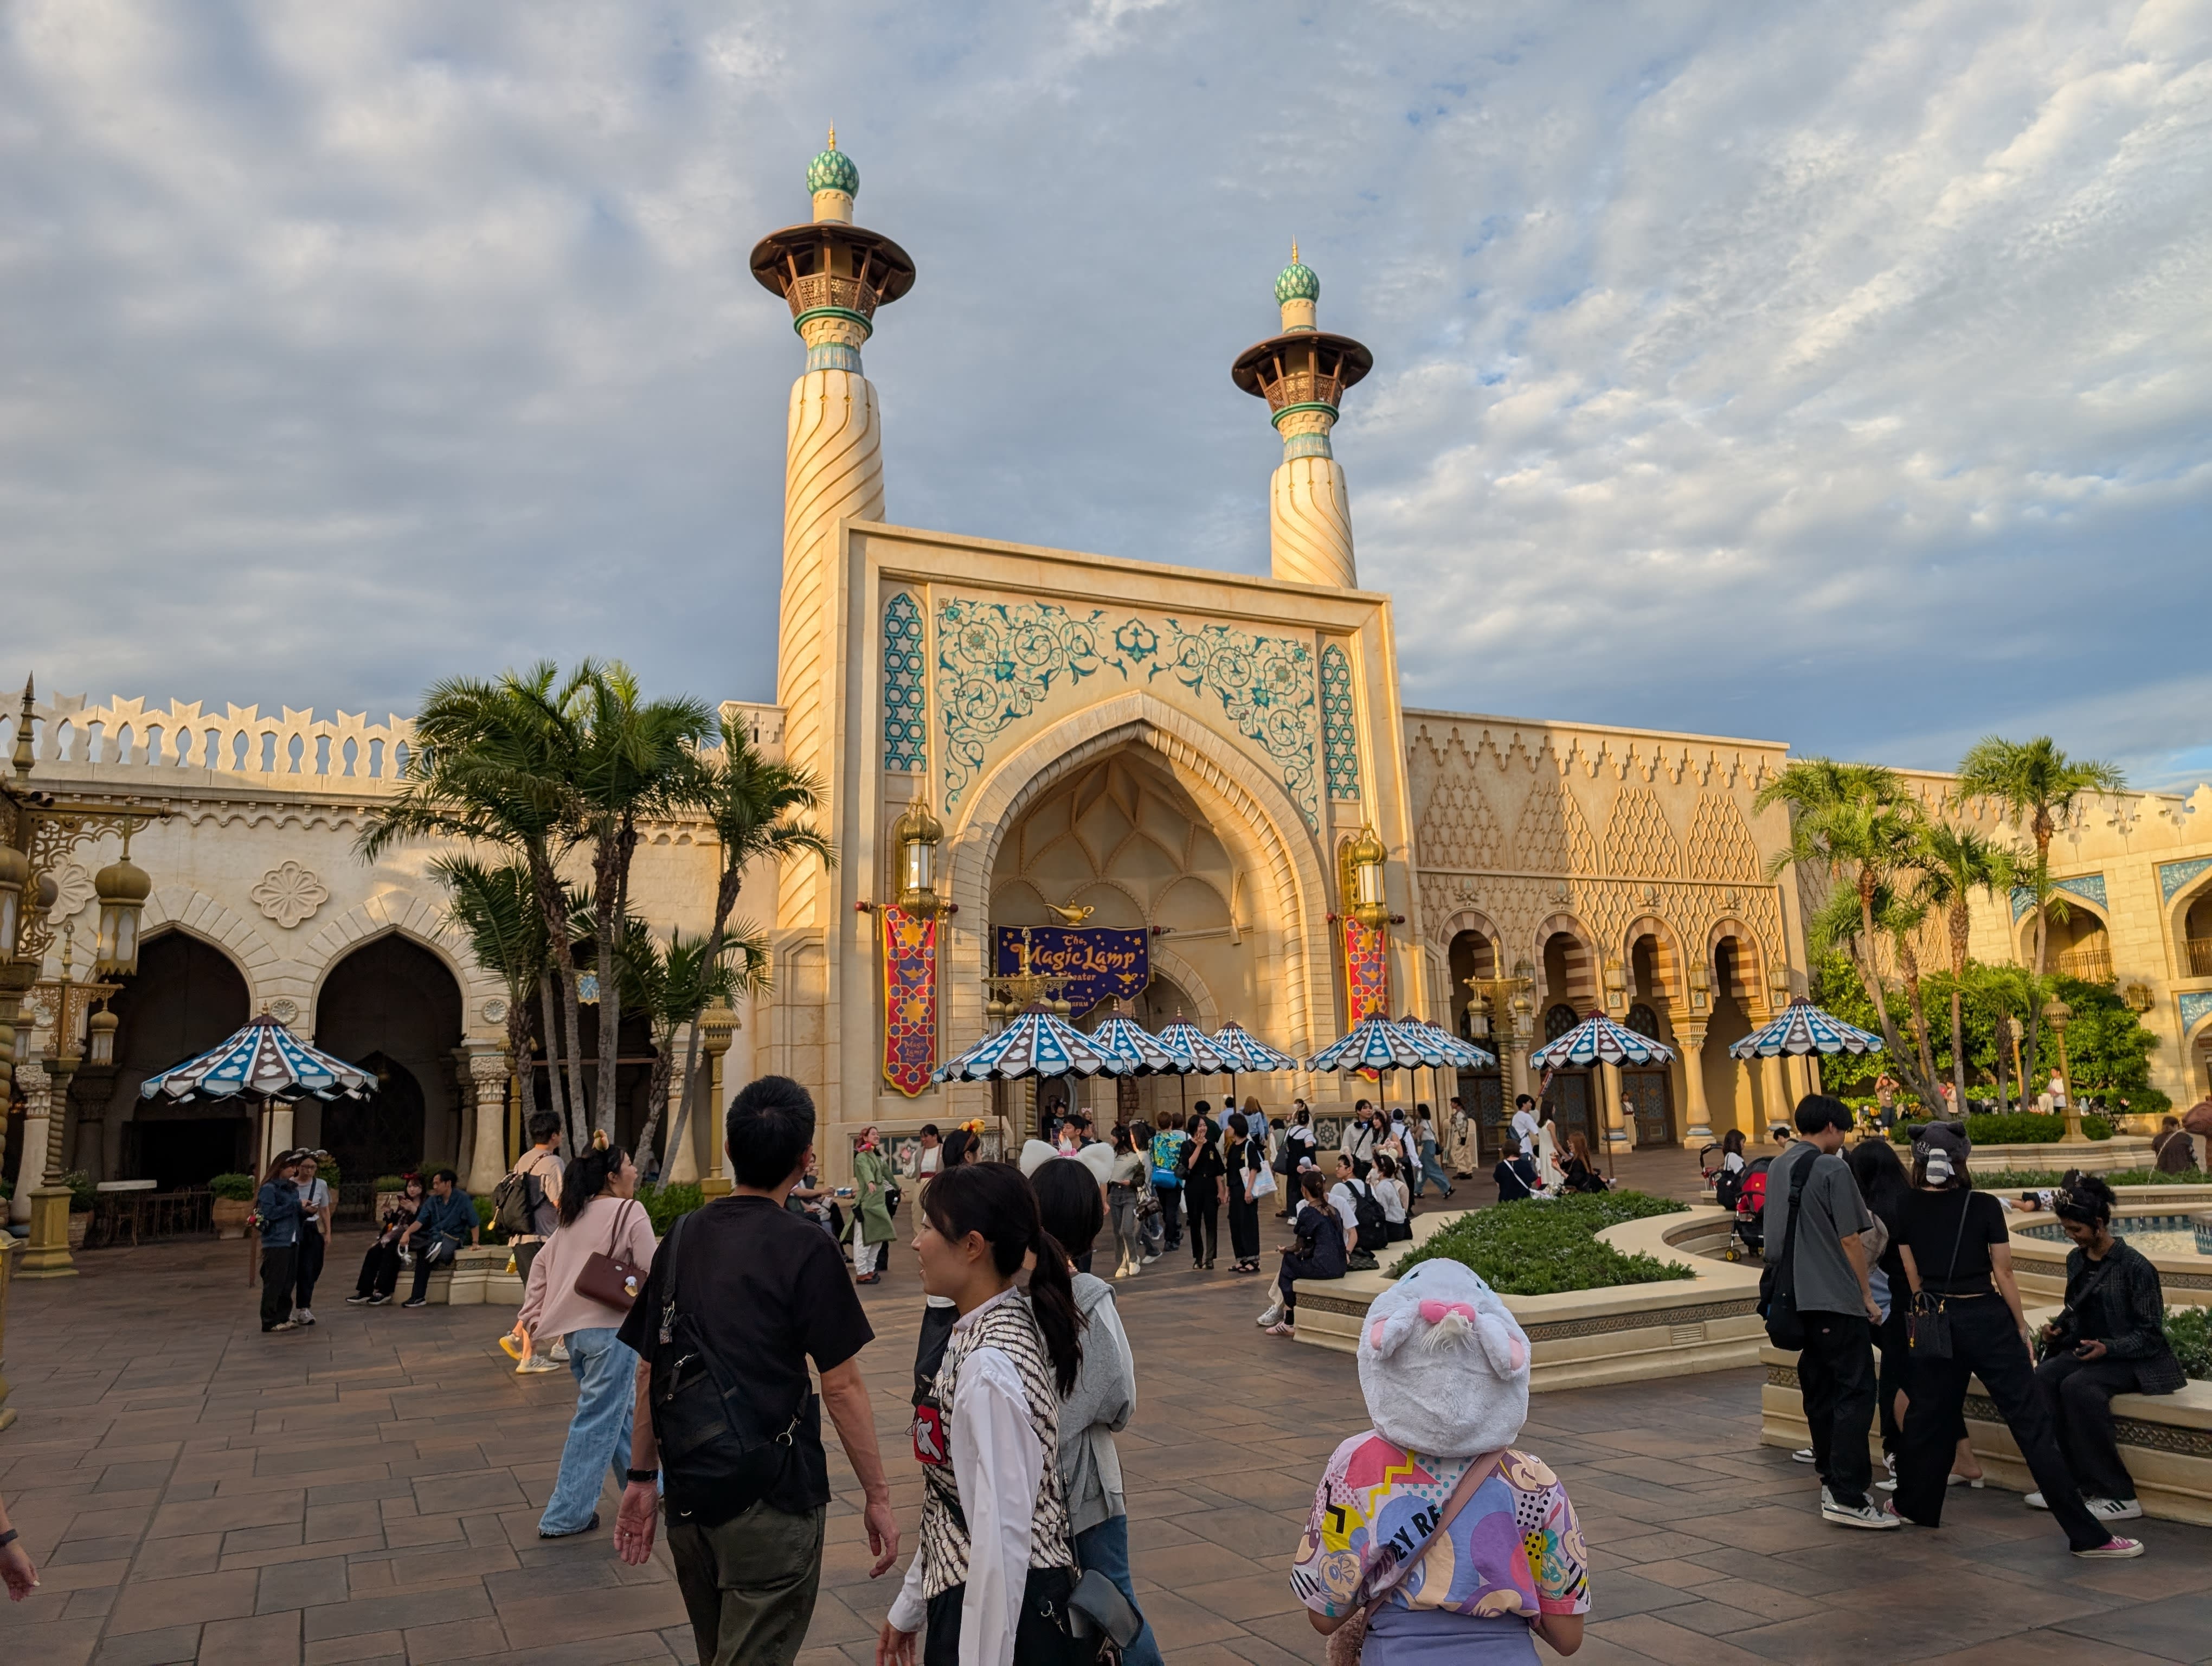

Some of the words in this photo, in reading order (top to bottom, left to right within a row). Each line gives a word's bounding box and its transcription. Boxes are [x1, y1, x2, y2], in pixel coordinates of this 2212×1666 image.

[1062, 934, 1087, 946] The
[1009, 943, 1083, 970] Magic
[1082, 945, 1136, 973] Lamp
[902, 1040, 926, 1049] Magic
